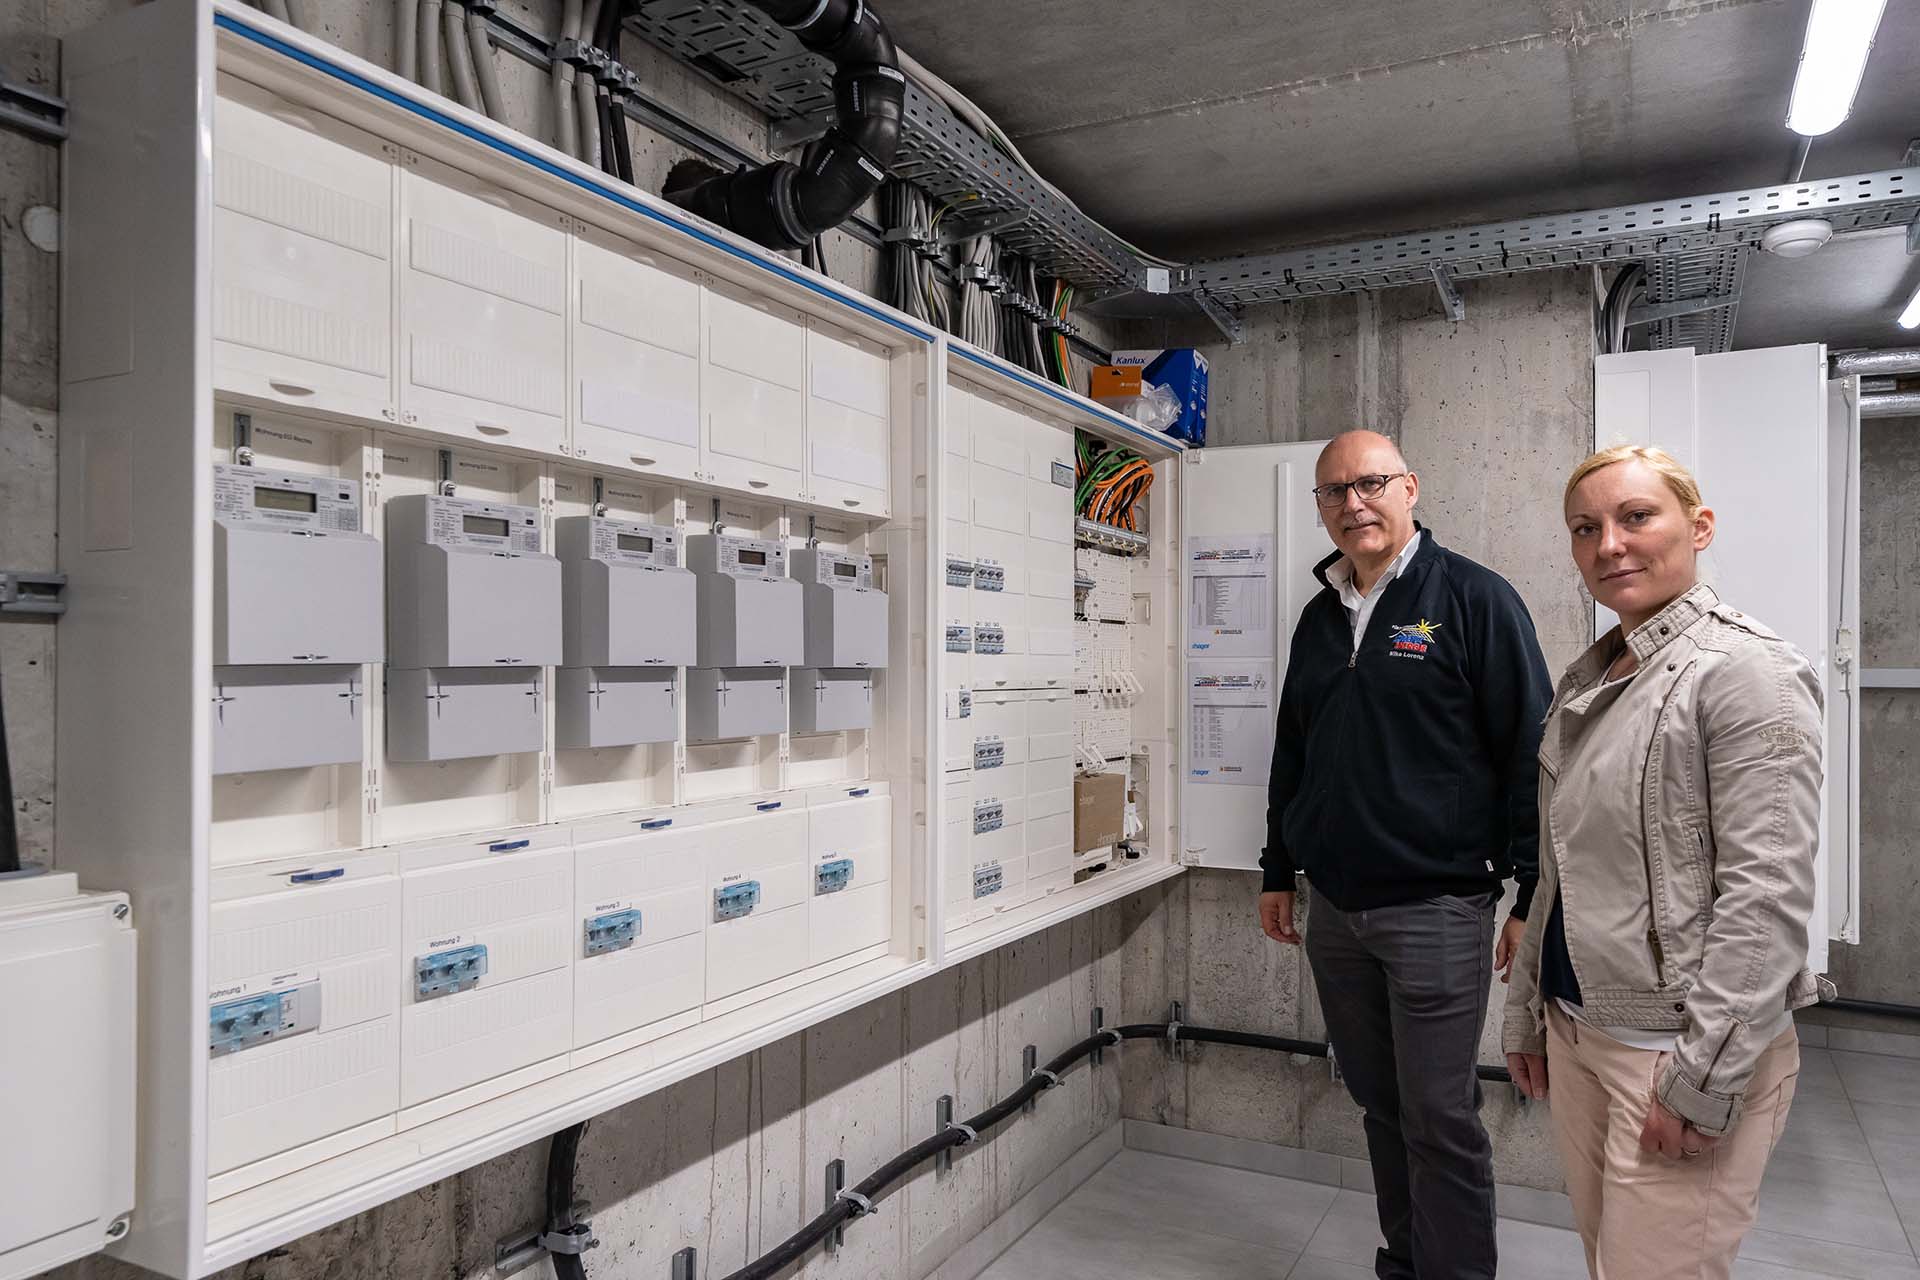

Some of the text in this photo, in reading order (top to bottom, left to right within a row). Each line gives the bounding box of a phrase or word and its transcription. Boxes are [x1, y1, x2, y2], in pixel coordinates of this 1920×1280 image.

[1115, 356, 1145, 364] Kanlux
[595, 903, 616, 912] Wohnung
[430, 937, 455, 948] Wohnung
